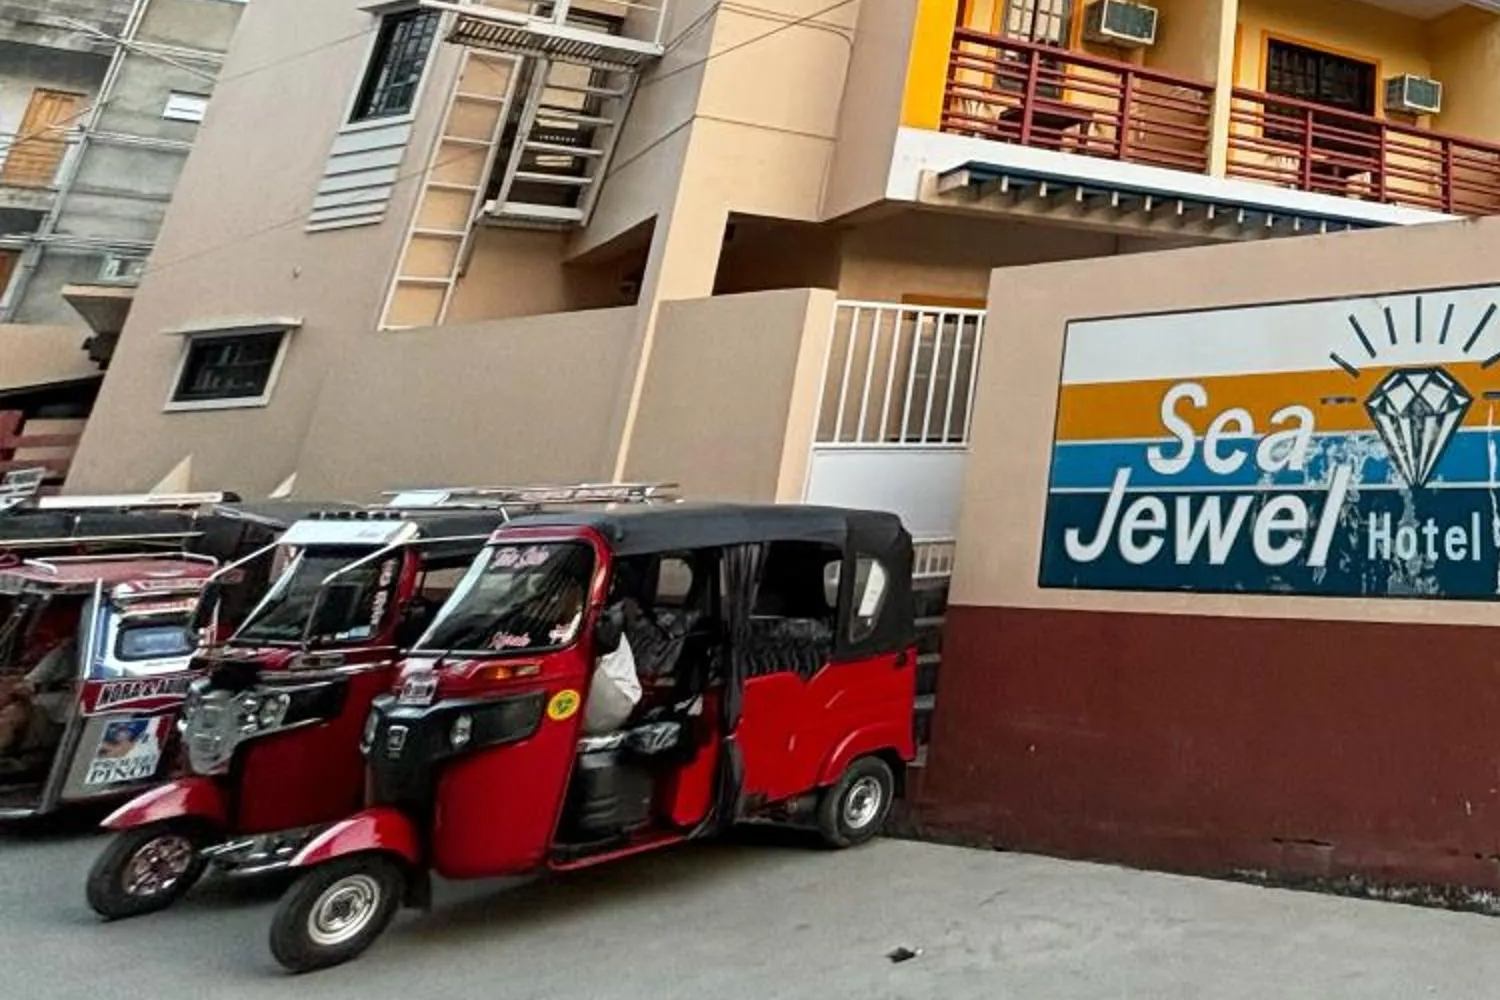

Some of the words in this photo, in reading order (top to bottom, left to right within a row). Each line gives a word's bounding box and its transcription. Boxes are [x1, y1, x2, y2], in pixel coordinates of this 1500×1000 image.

[1146, 382, 1315, 475] Sea
[1064, 463, 1354, 567] Jewel
[1366, 511, 1483, 562] Hotel
